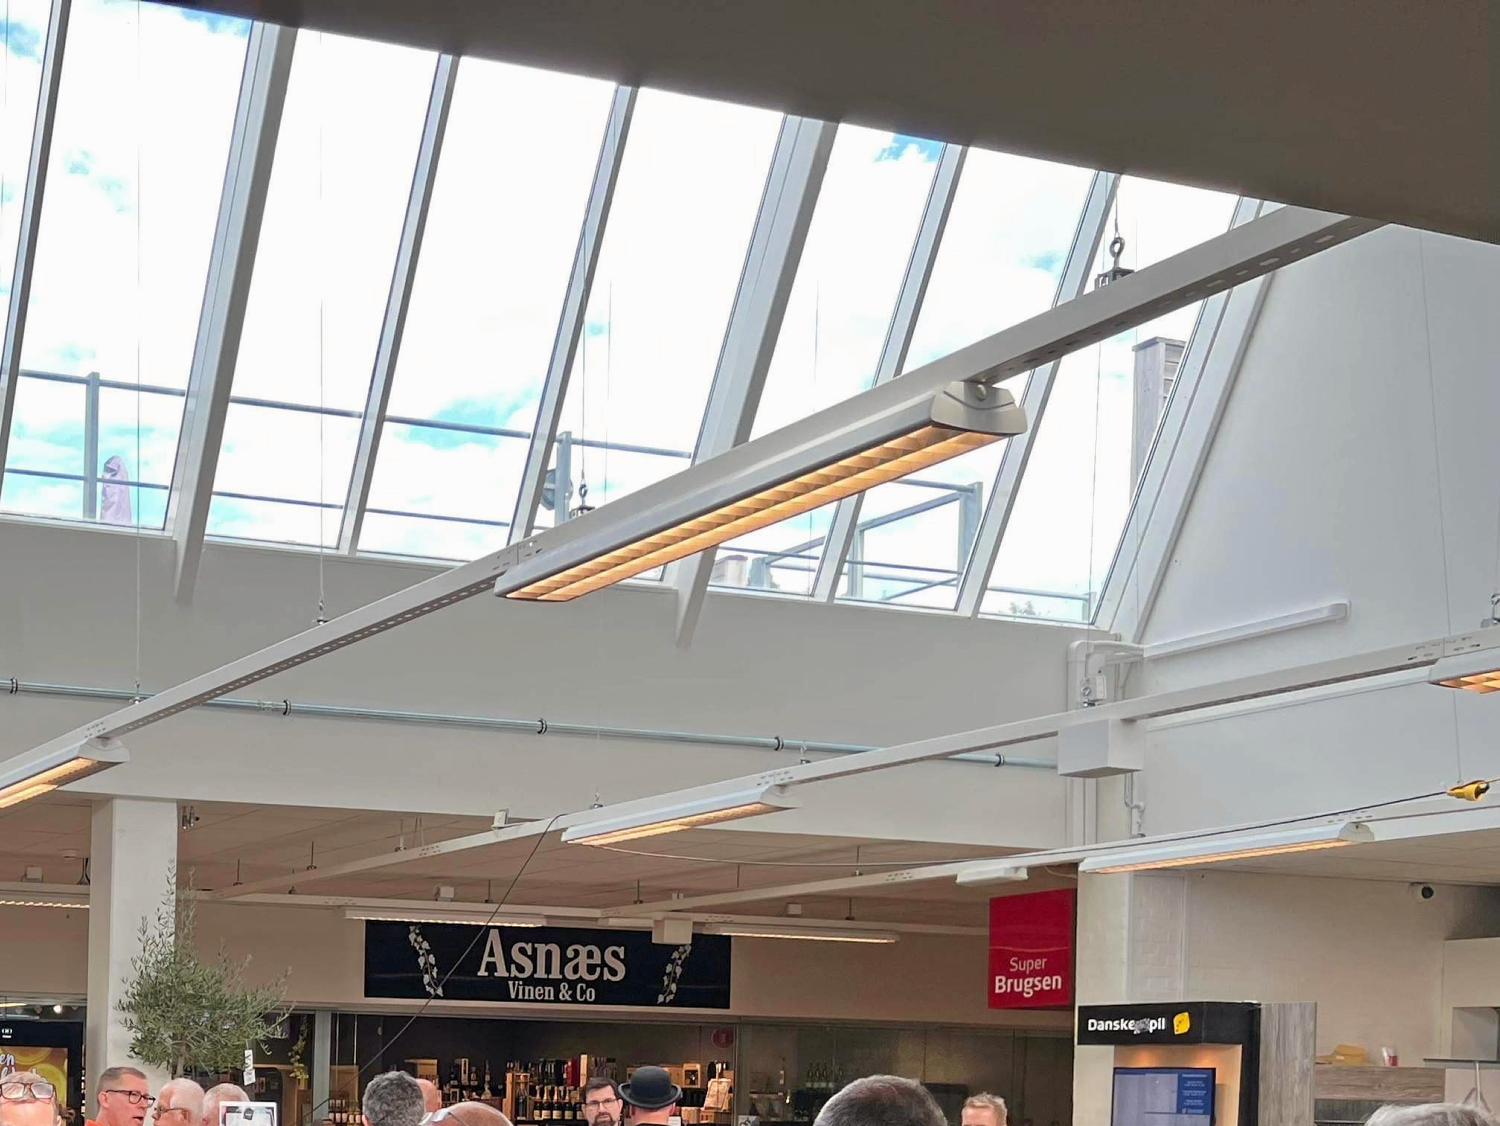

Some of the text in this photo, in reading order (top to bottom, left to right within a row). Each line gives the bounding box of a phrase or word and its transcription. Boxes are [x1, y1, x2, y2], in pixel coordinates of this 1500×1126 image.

[477, 928, 626, 982] Asnæs
[1010, 956, 1048, 975] Super
[508, 980, 595, 1002] Vinen & Co
[994, 974, 1063, 998] Brugsen
